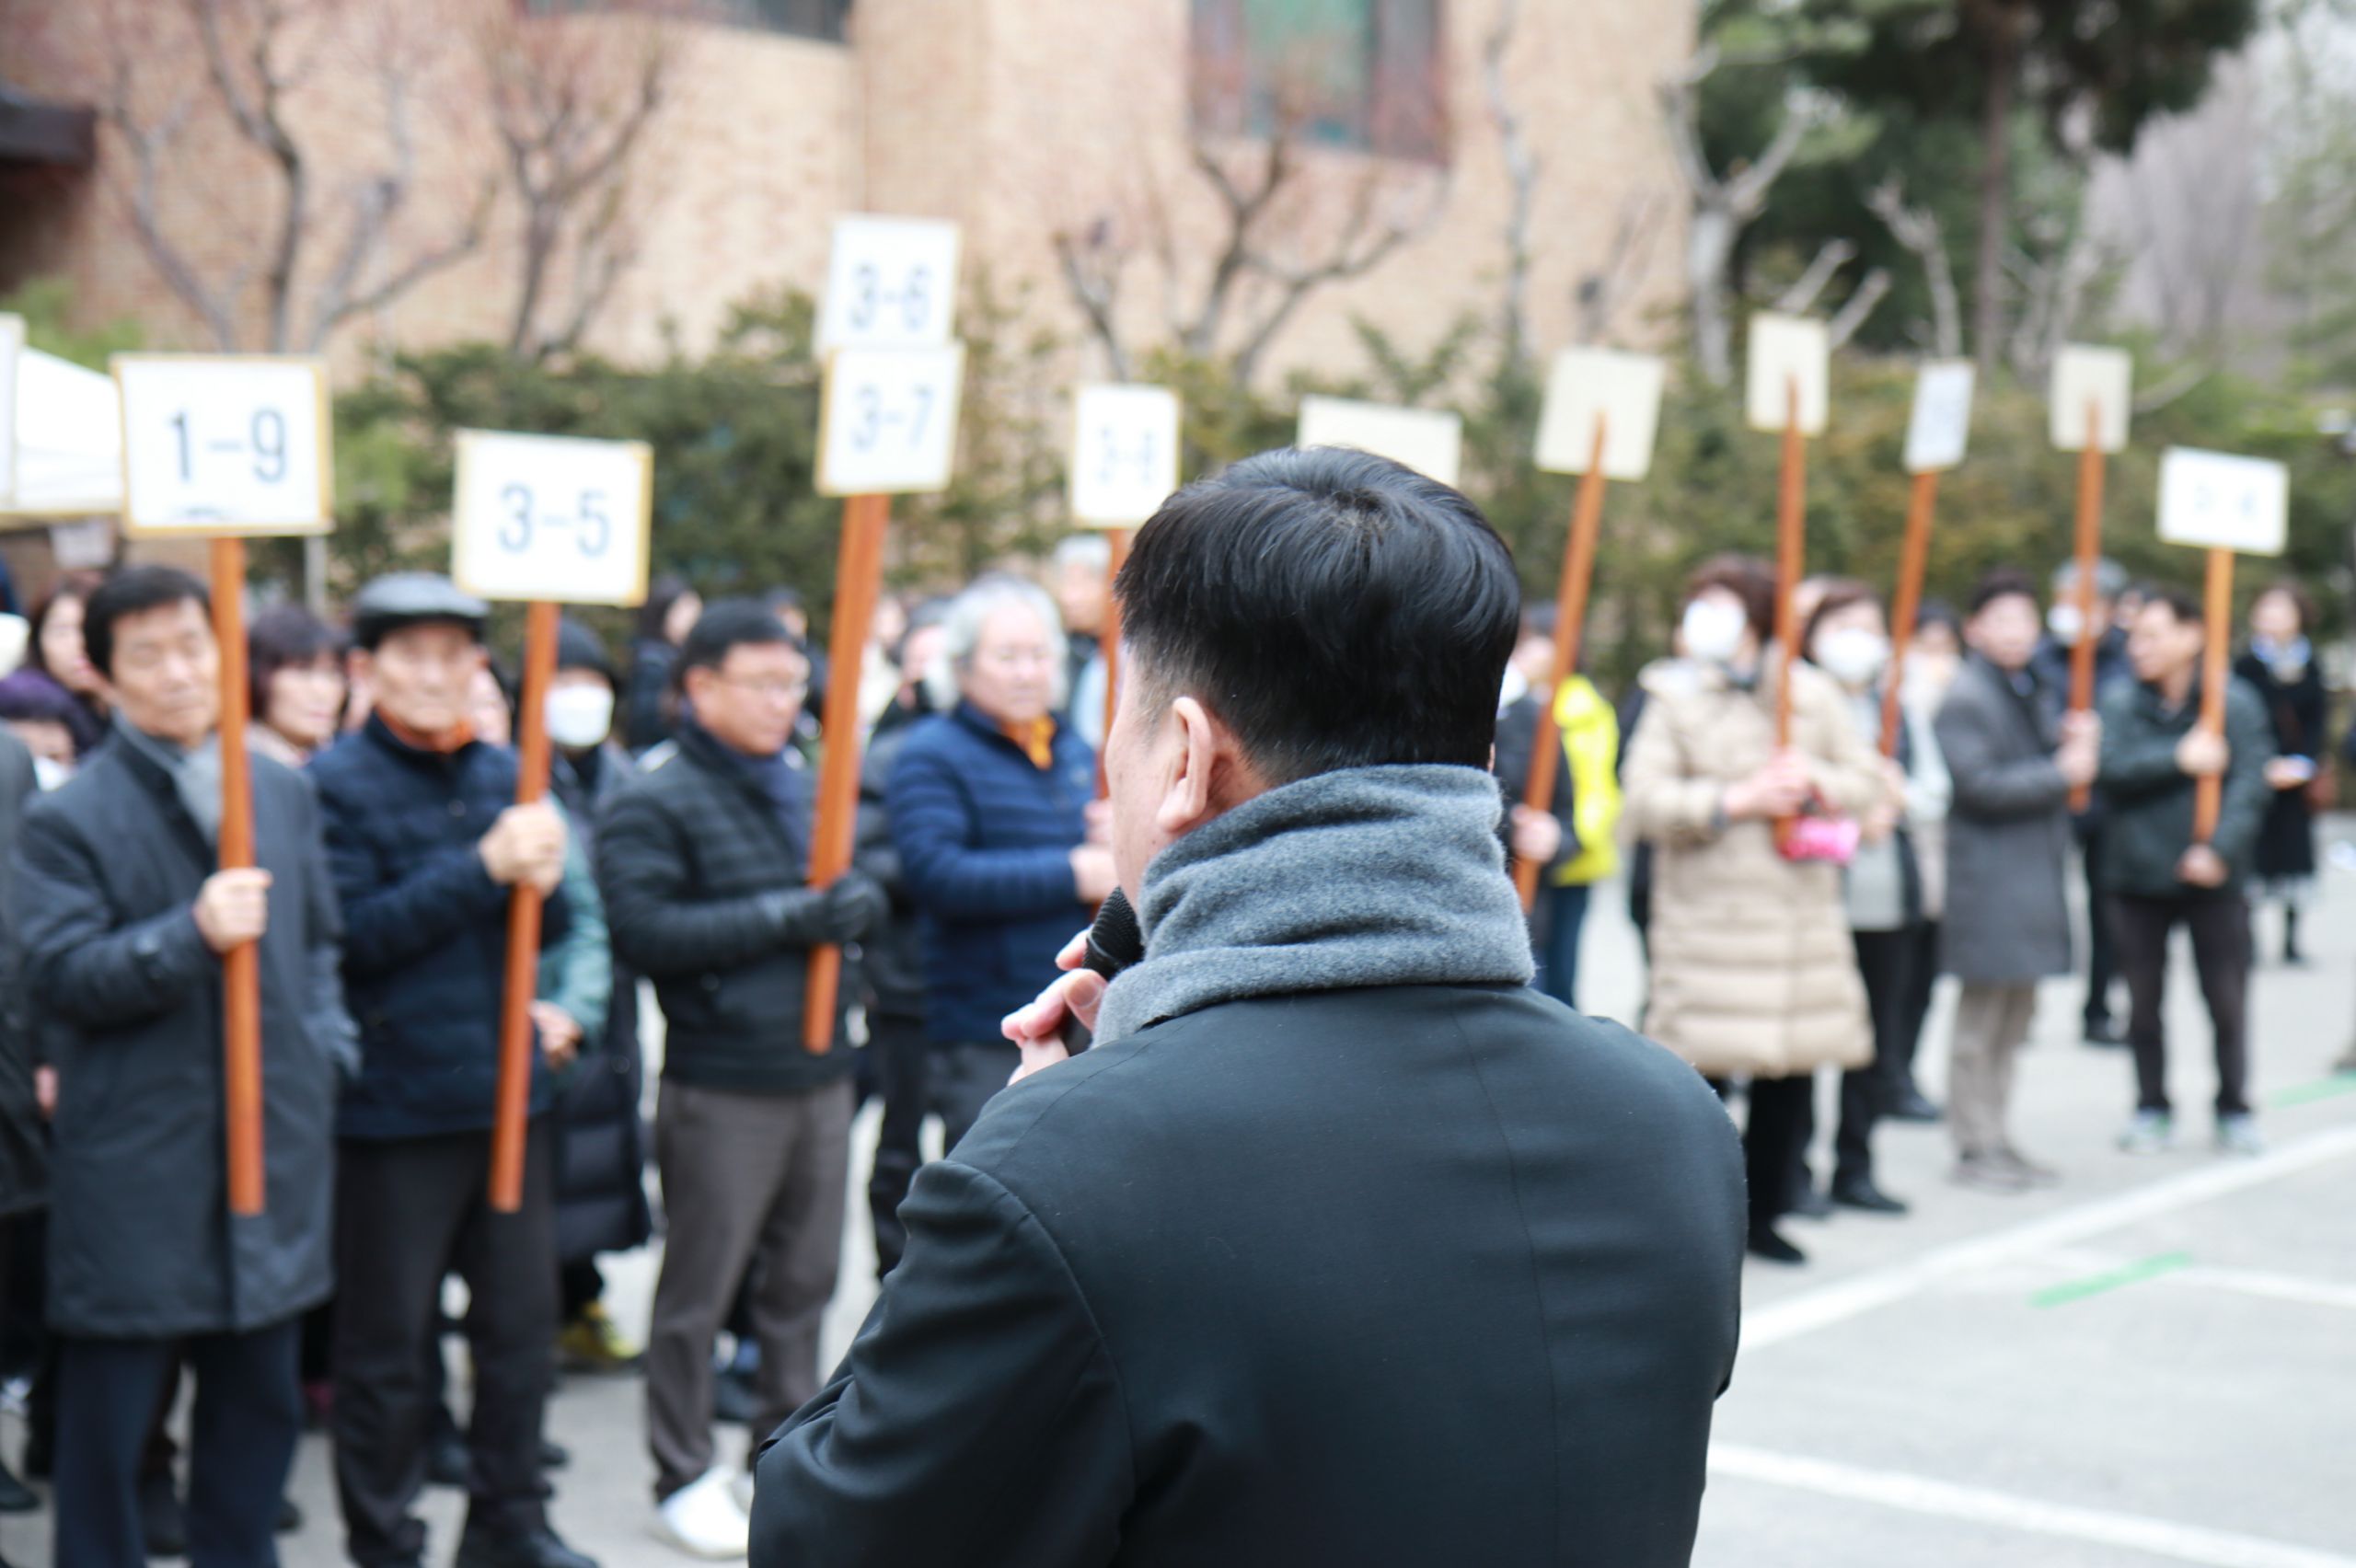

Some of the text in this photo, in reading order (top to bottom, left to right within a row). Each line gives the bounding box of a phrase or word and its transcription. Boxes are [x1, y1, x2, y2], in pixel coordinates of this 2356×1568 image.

[169, 407, 287, 483] 1-9
[849, 383, 935, 453] 3-7
[499, 481, 609, 557] 3-5
